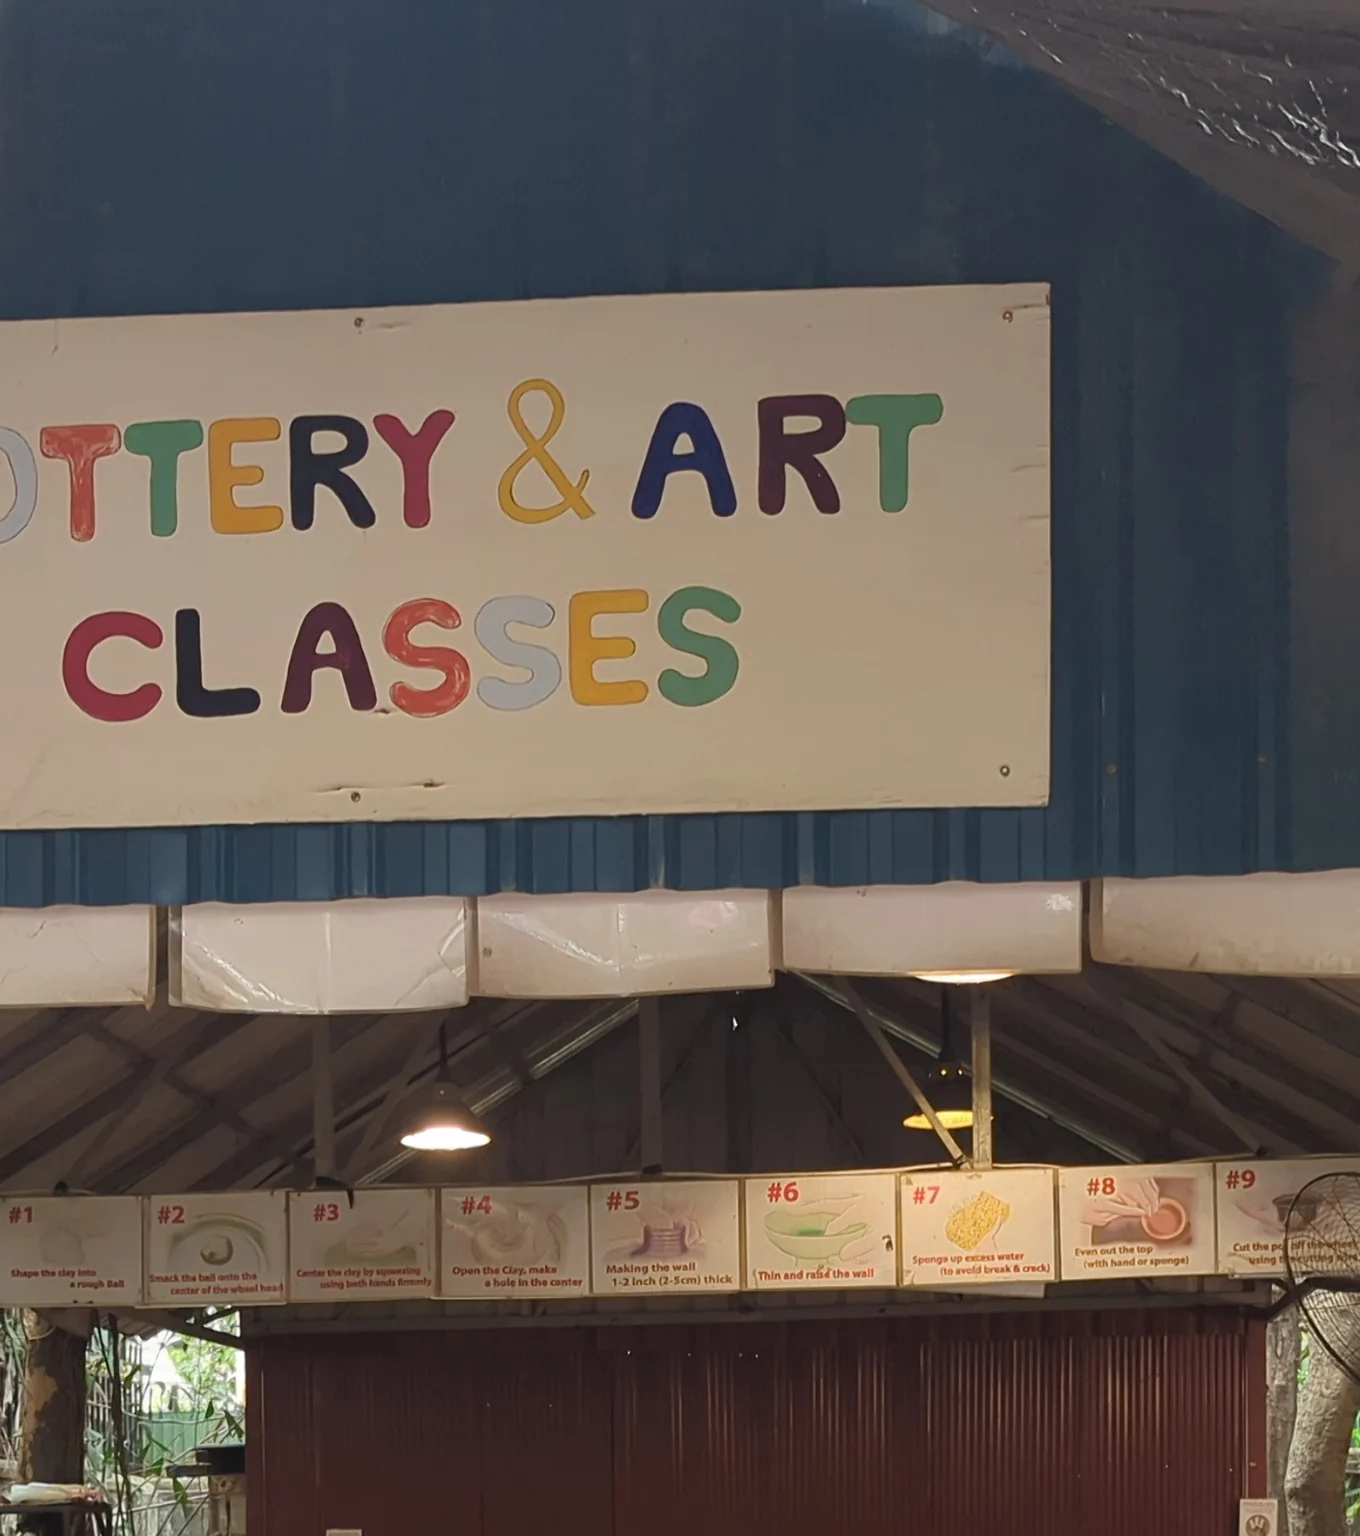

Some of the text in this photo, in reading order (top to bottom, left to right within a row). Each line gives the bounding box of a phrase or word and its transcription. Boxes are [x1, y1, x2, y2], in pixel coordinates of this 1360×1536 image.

[497, 378, 597, 524] &
[629, 393, 944, 519] ART
[61, 585, 742, 722] CLASSES
[1225, 1169, 1256, 1189] #9
[767, 1182, 799, 1203] #6
[1087, 1177, 1116, 1196] #8
[606, 1190, 640, 1211] #5
[912, 1186, 940, 1205] #7
[461, 1195, 493, 1215] #4
[9, 1206, 34, 1224] #1
[157, 1205, 186, 1224] #2
[313, 1203, 340, 1222] #3
[1075, 1245, 1154, 1256] Even out the top
[1233, 1243, 1250, 1252] Cut
[1252, 1242, 1270, 1251] the
[912, 1253, 1024, 1266] Sponge up excess water
[1084, 1259, 1108, 1269] (with
[1111, 1257, 1136, 1267] hand
[1150, 1256, 1189, 1267] sponge)
[1249, 1255, 1277, 1266] using
[11, 1269, 39, 1279] Shape
[41, 1269, 57, 1277] the
[58, 1268, 76, 1279] clay
[296, 1267, 421, 1278] Center the clay by squeezing
[452, 1266, 481, 1276] Open
[483, 1266, 500, 1275] the
[528, 1265, 557, 1274] make
[606, 1262, 696, 1275] Making the wall
[757, 1271, 781, 1281] Thin
[783, 1270, 804, 1280] and
[832, 1268, 850, 1278] the
[852, 1268, 874, 1278] wall
[940, 1263, 1051, 1276] (to avoid break & crack)
[149, 1272, 258, 1283] Smack the ball onto the
[320, 1280, 344, 1290] using
[346, 1279, 367, 1289] both
[369, 1278, 396, 1288] hands
[493, 1278, 516, 1288] hole
[518, 1278, 528, 1287] in
[530, 1278, 548, 1287] the
[550, 1278, 583, 1287] center
[612, 1274, 733, 1287] 1-2 inch (2-5cm) thick
[77, 1280, 105, 1290] rough
[170, 1283, 284, 1295] center of the wheel head
